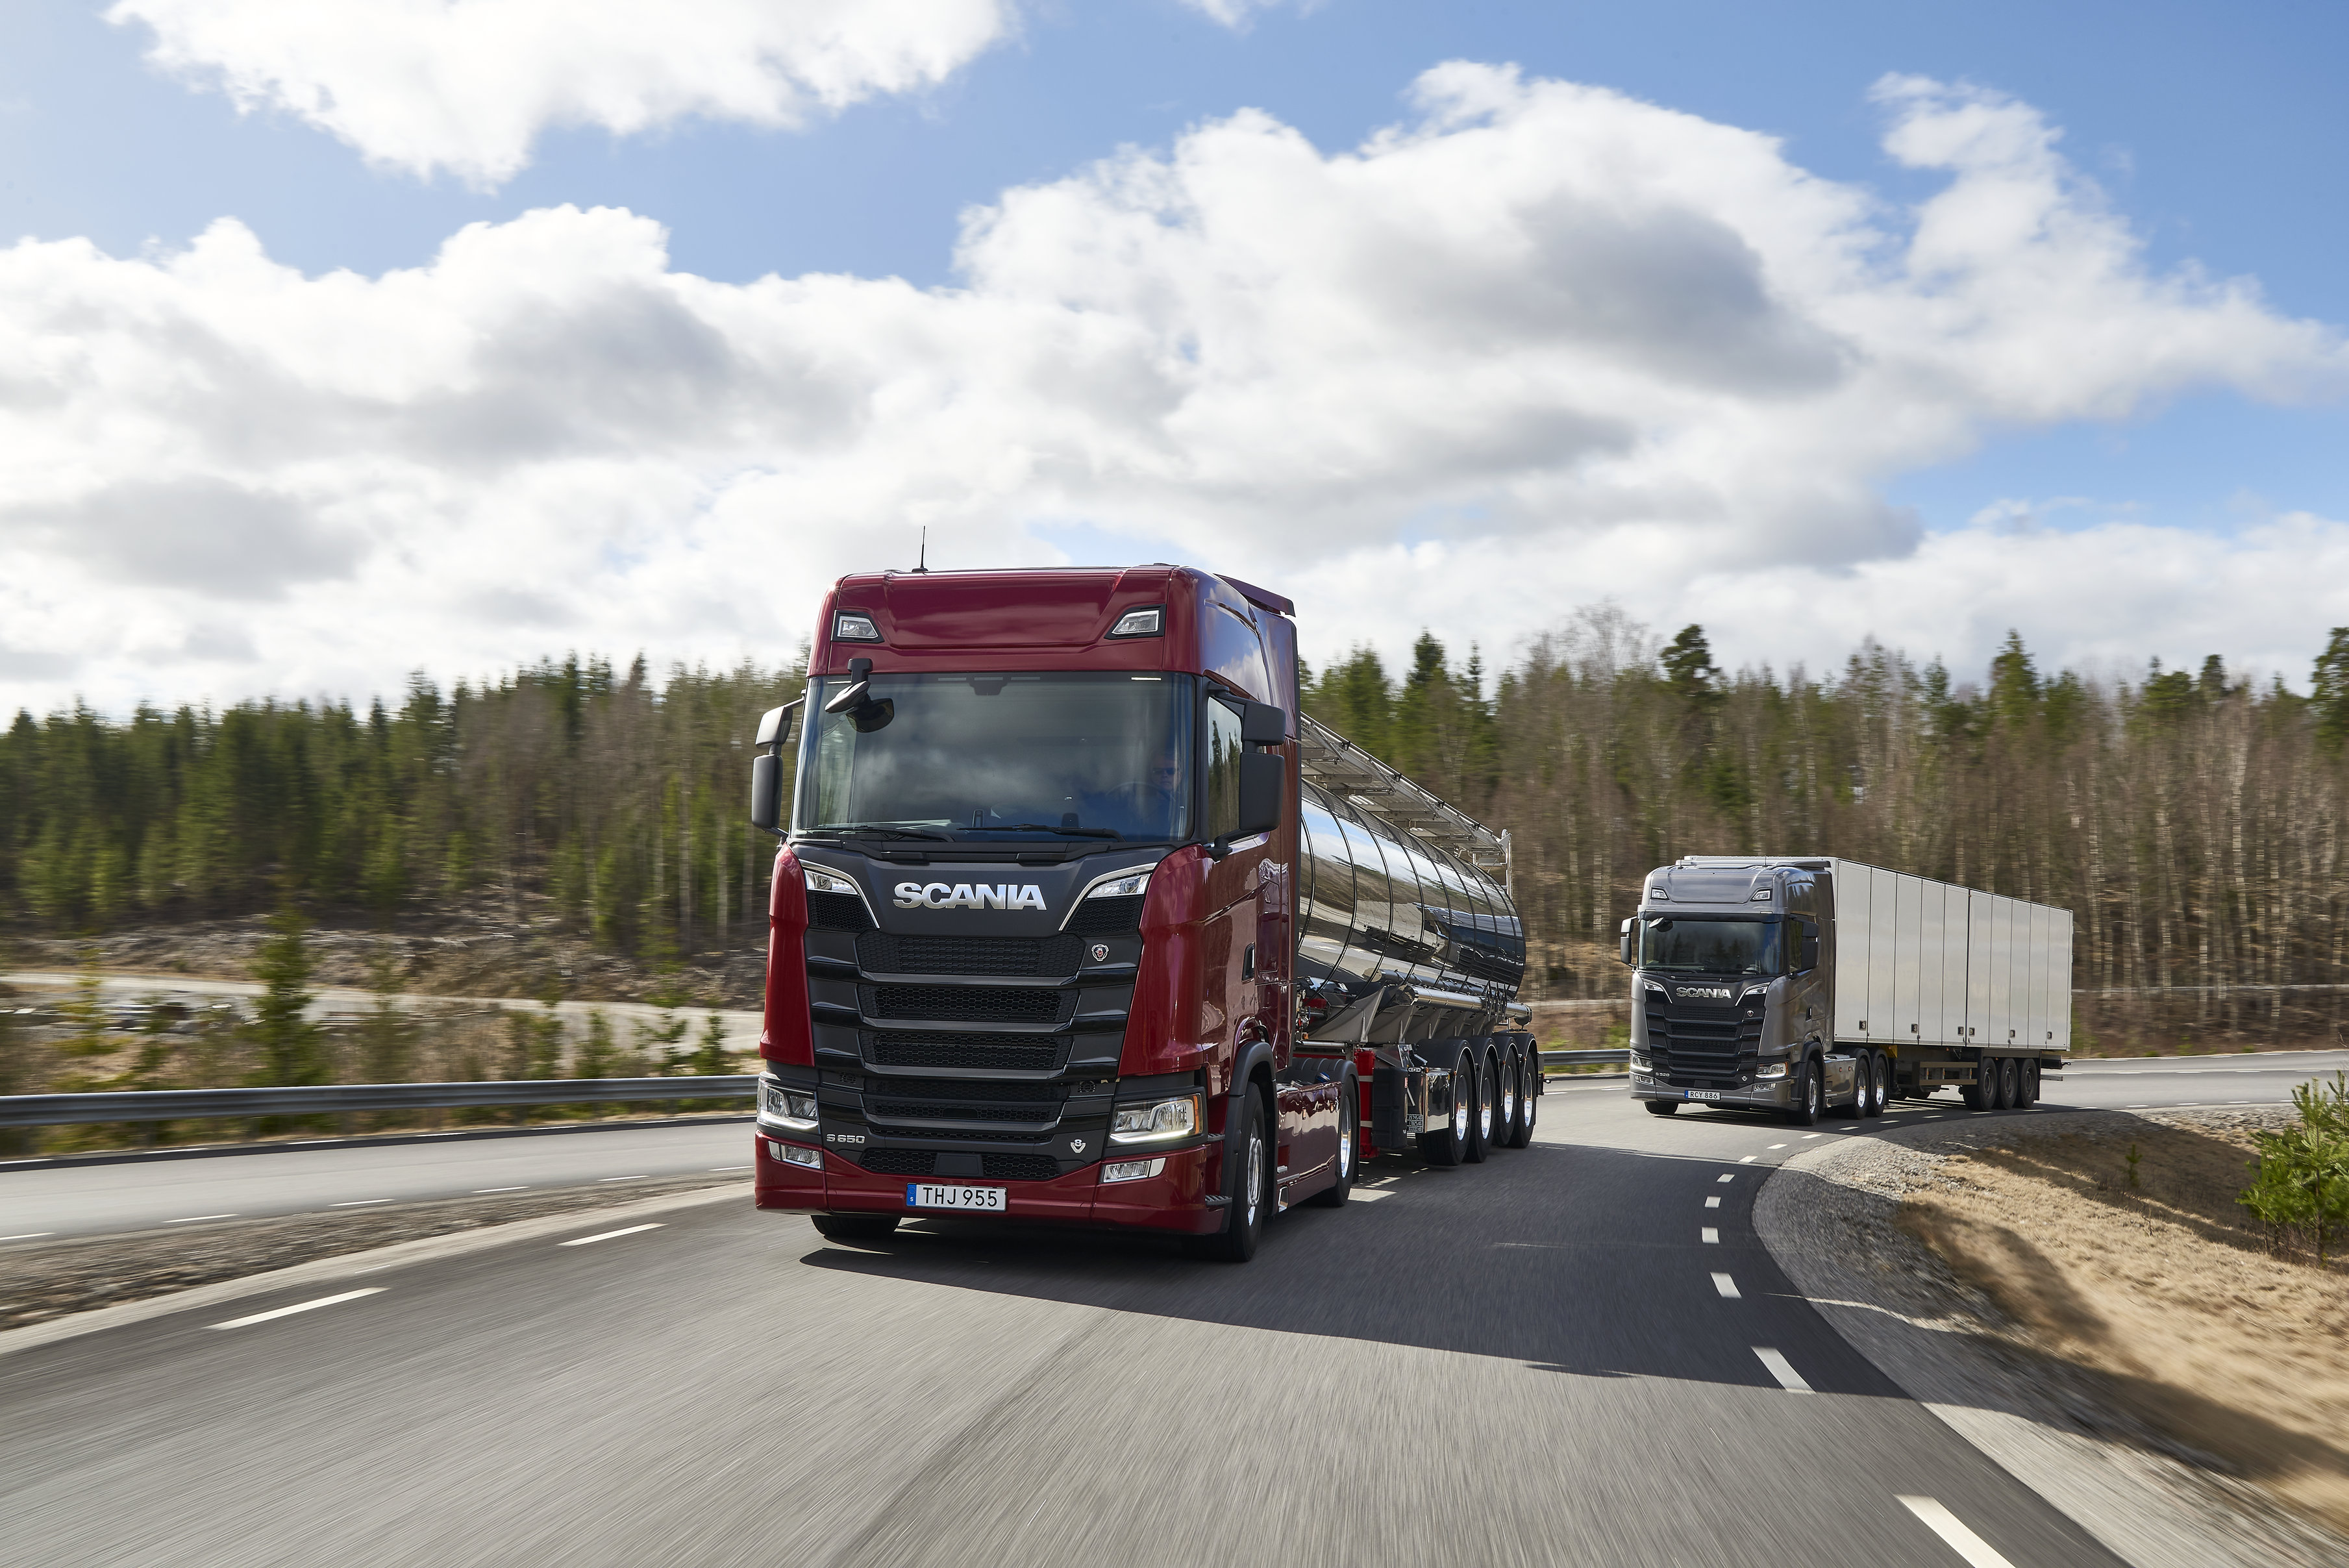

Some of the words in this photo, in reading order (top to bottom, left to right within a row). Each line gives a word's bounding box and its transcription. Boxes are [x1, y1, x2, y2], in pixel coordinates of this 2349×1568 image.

[893, 882, 1047, 910] SCANIA
[1676, 987, 1732, 999] SCANIA
[826, 1134, 836, 1142] S
[837, 1134, 865, 1144] 650
[923, 1187, 956, 1204] THJ
[963, 1189, 998, 1207] 955
